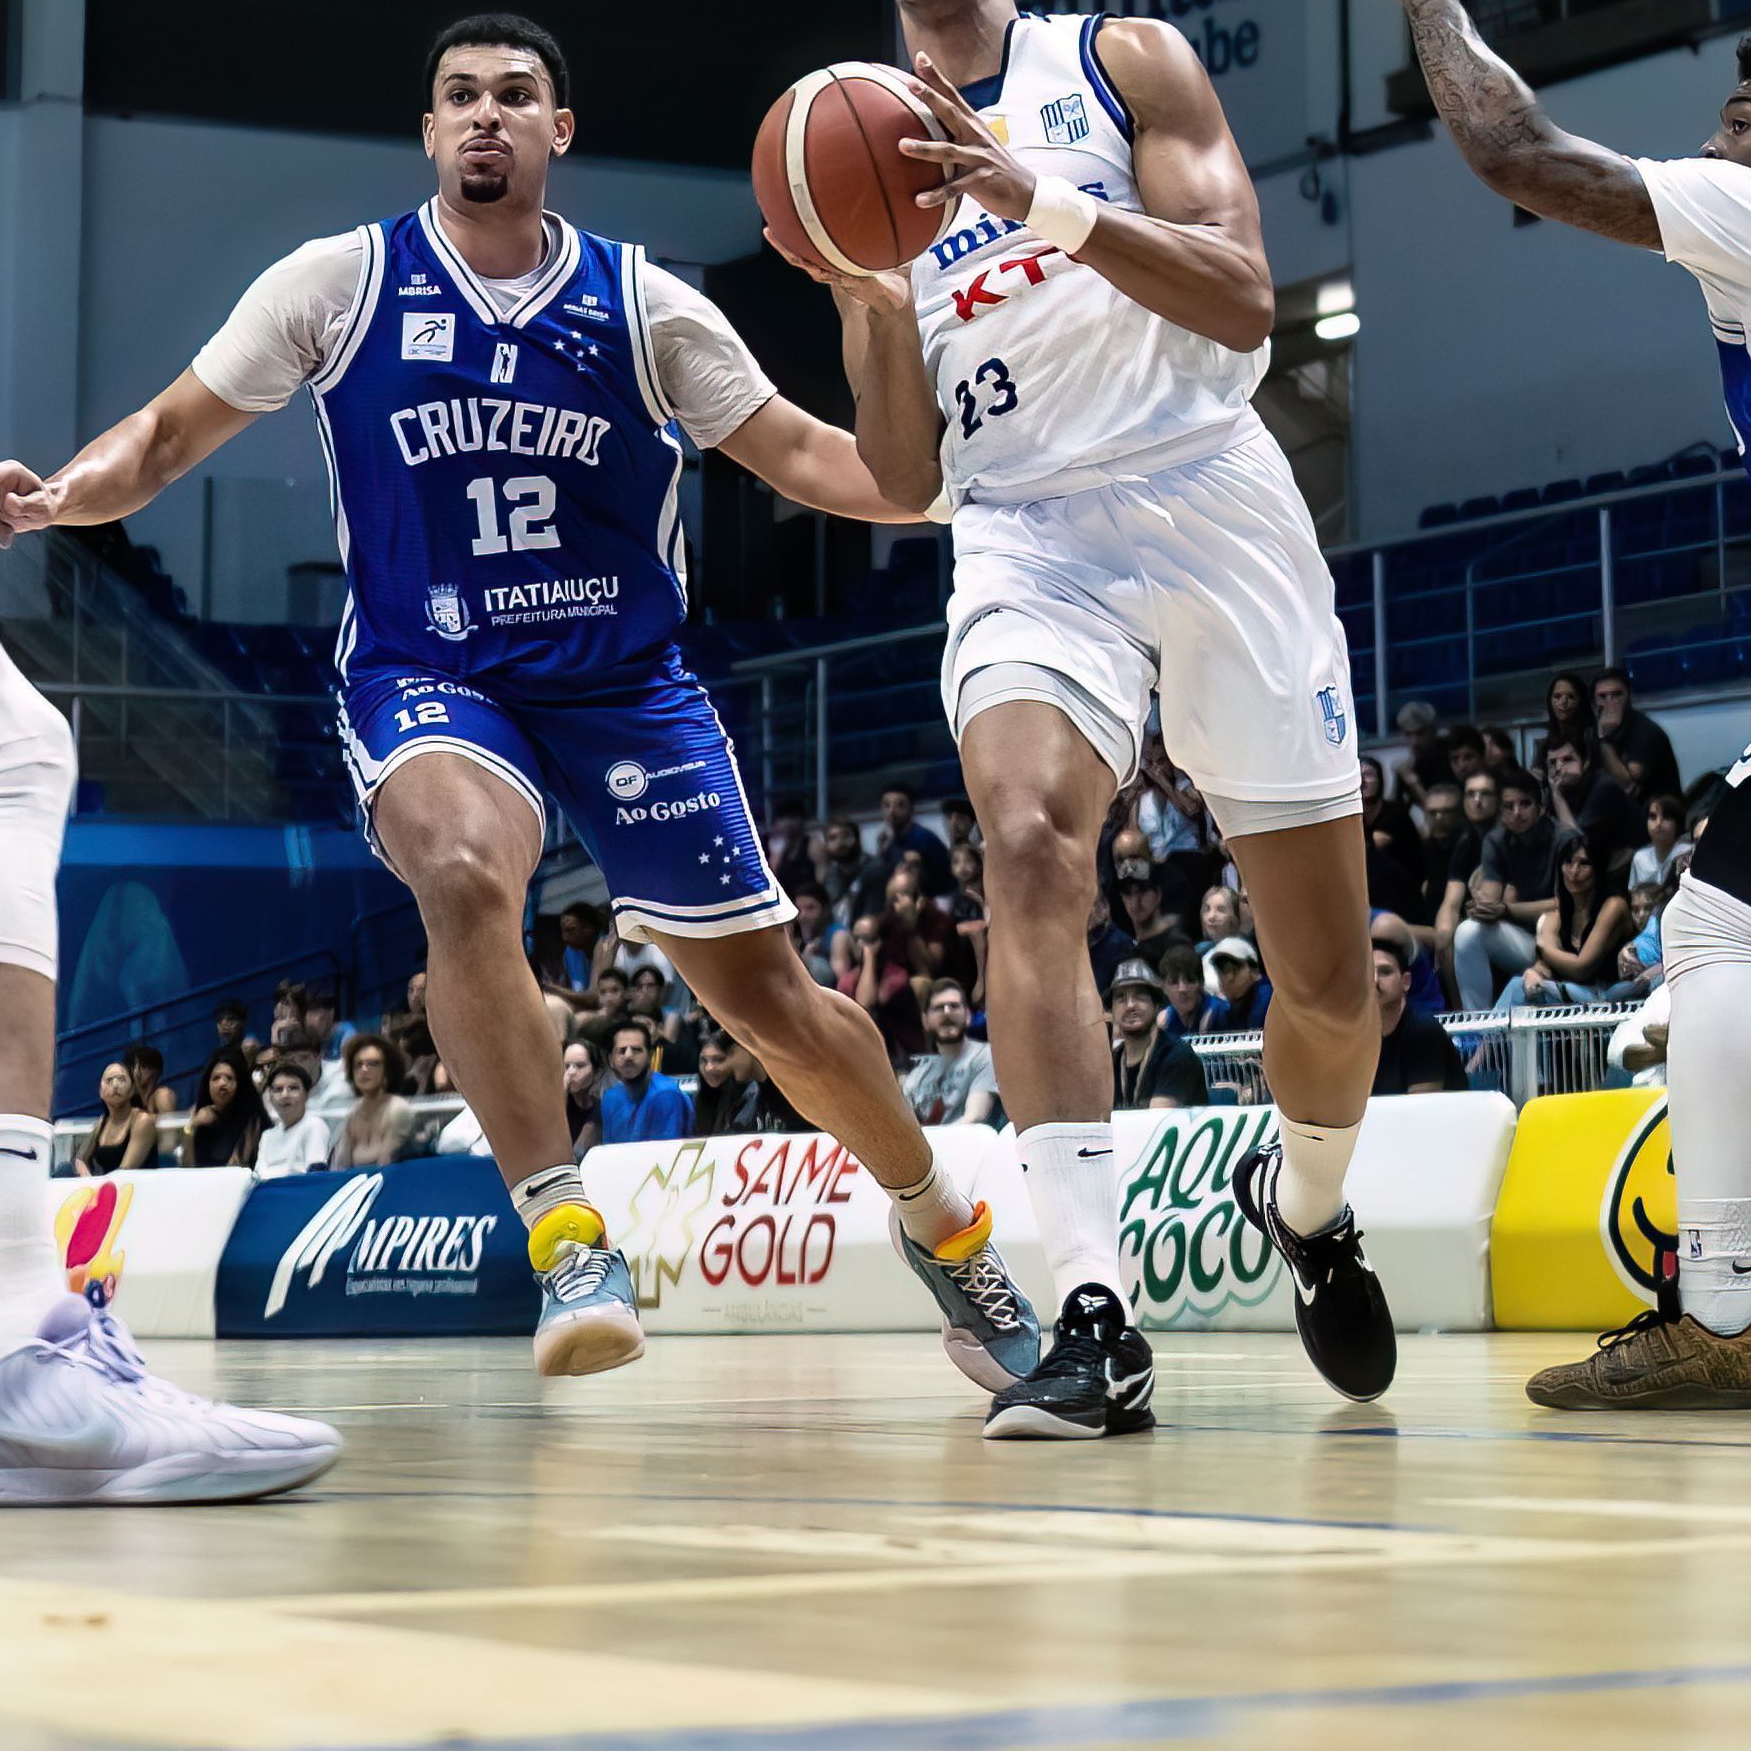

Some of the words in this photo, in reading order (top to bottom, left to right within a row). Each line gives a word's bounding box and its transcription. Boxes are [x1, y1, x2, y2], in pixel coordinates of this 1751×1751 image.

[390, 398, 611, 466] CRUZEIRO
[955, 358, 1018, 441] 23
[466, 475, 561, 556] 12
[484, 576, 619, 611] ITATIAIUÇU
[491, 609, 566, 626] PREFEITURA
[394, 701, 450, 733] 12
[616, 807, 647, 825] Ao
[650, 791, 721, 821] Gosto
[722, 1138, 859, 1207] SAME
[1120, 1111, 1280, 1223] AQU
[700, 1214, 836, 1287] GOLD
